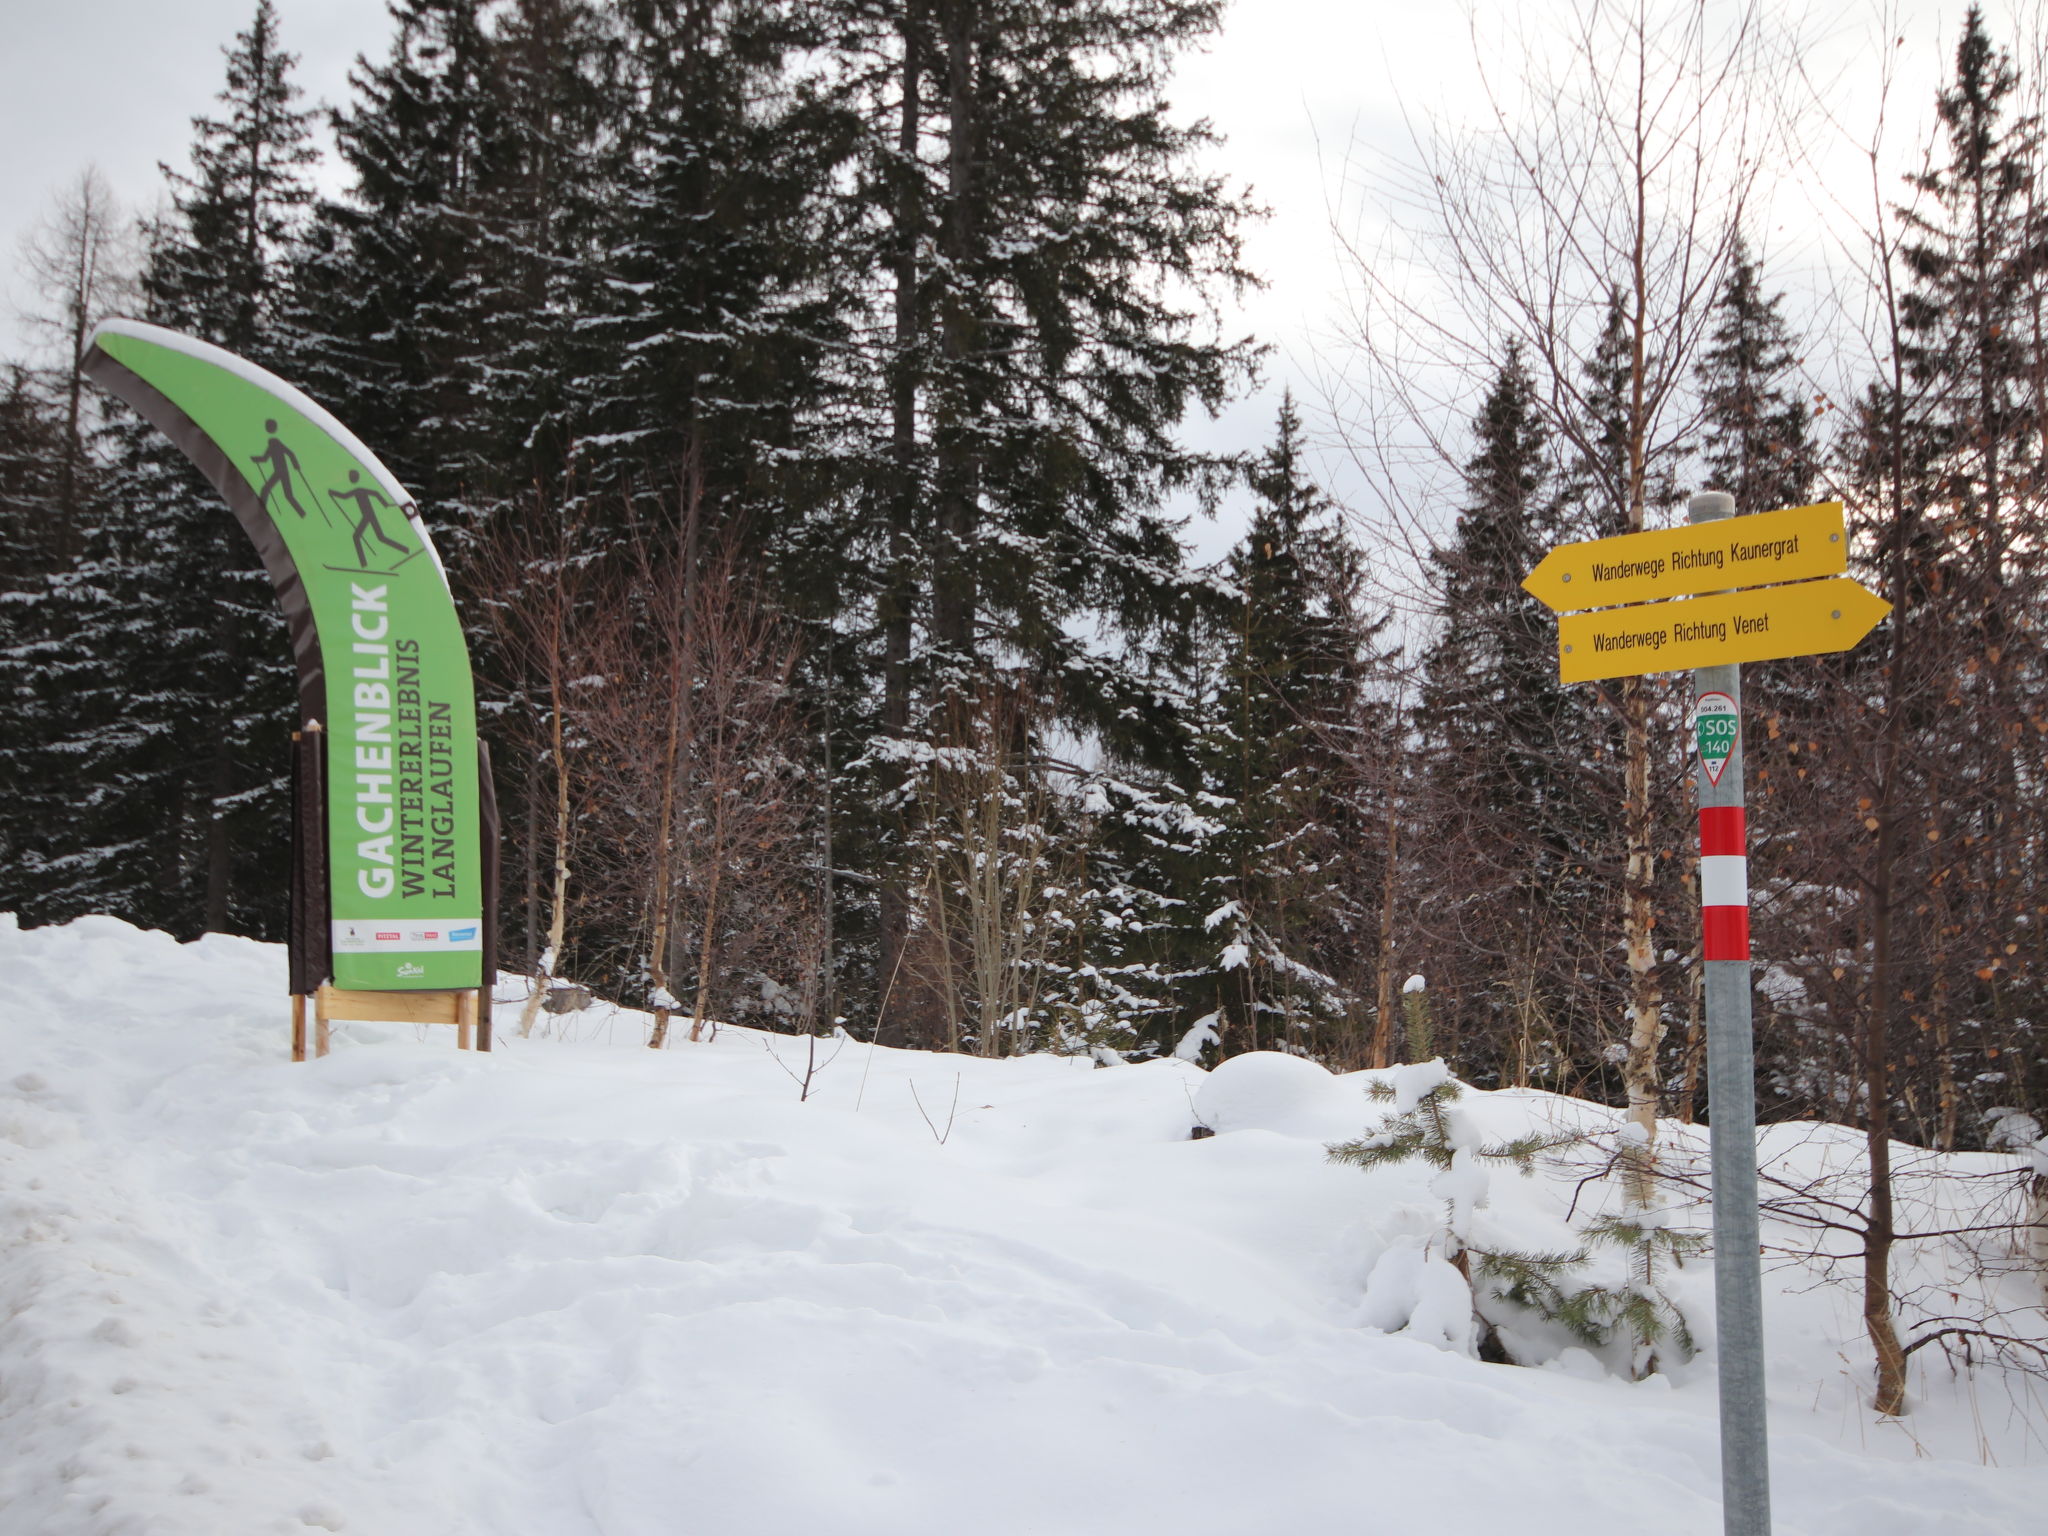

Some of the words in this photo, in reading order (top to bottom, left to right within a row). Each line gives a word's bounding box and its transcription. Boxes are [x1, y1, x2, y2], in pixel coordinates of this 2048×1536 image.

[1592, 558, 1664, 582] Wanderwege
[1672, 547, 1724, 572] Richtung
[1731, 535, 1799, 563] Kaunergrat
[1593, 628, 1667, 653] Wanderwege
[1674, 617, 1726, 643] Richtung
[1733, 612, 1769, 635] Venet
[351, 582, 395, 899] GACHENBLICK
[1706, 720, 1736, 735] SOS
[1706, 741, 1729, 754] 140
[396, 638, 425, 900] WINTERERLEBNIS
[428, 700, 456, 899] LANGLAUFEN
